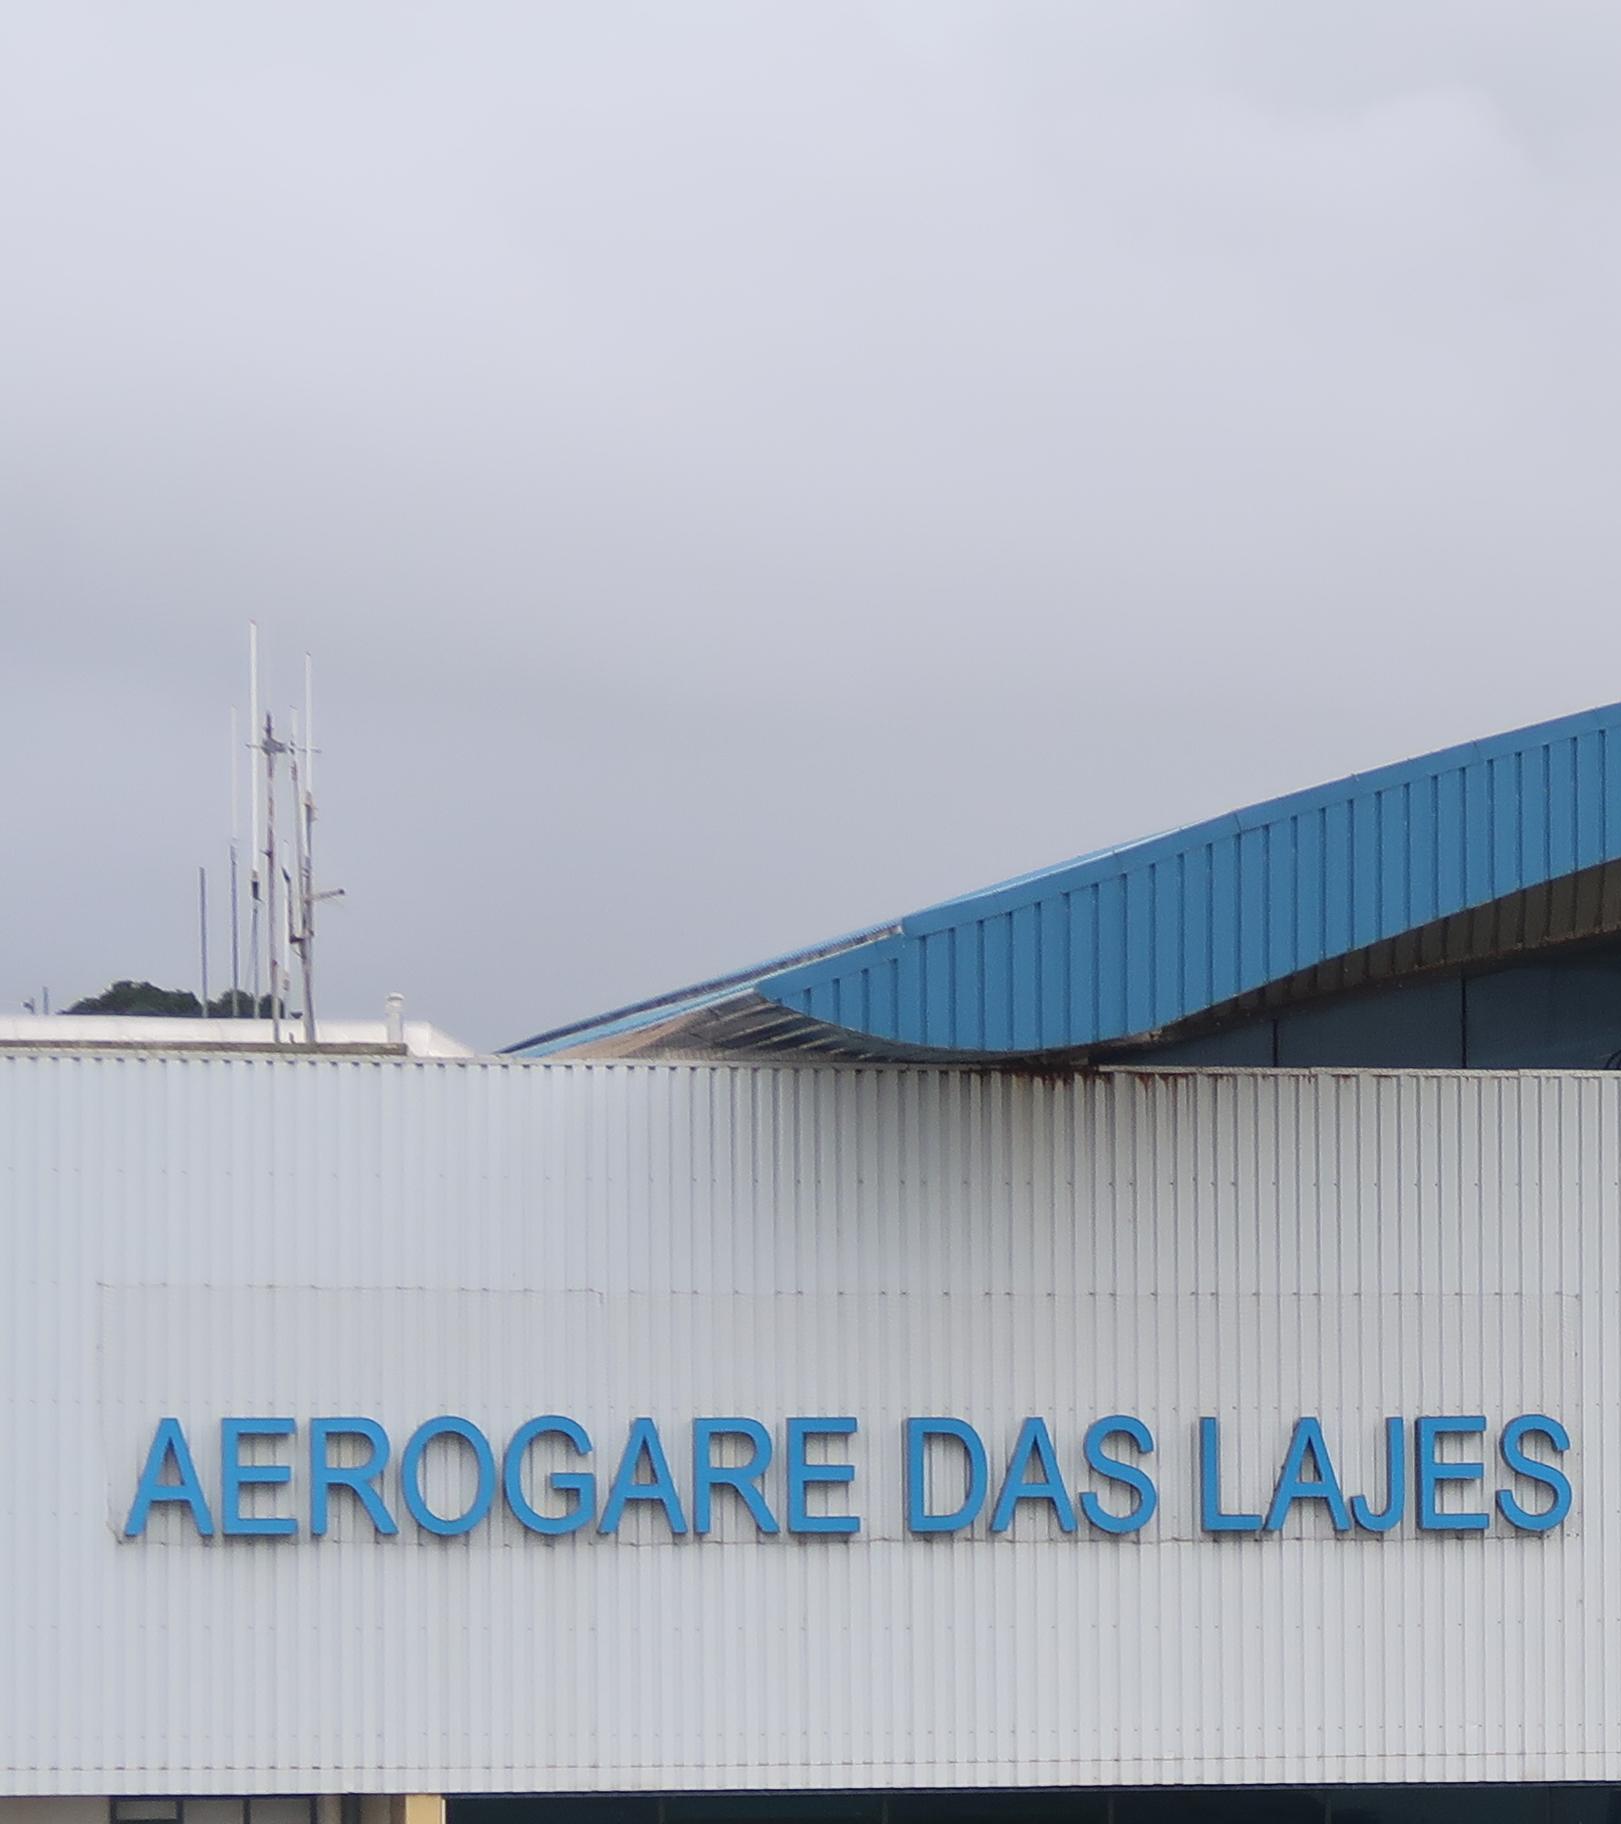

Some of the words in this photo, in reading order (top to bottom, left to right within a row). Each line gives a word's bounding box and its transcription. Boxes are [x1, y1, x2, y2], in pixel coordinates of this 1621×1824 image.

[124, 1413, 862, 1537] AEROGARE
[906, 1413, 1160, 1534] DAS
[1200, 1413, 1574, 1532] LAJES
